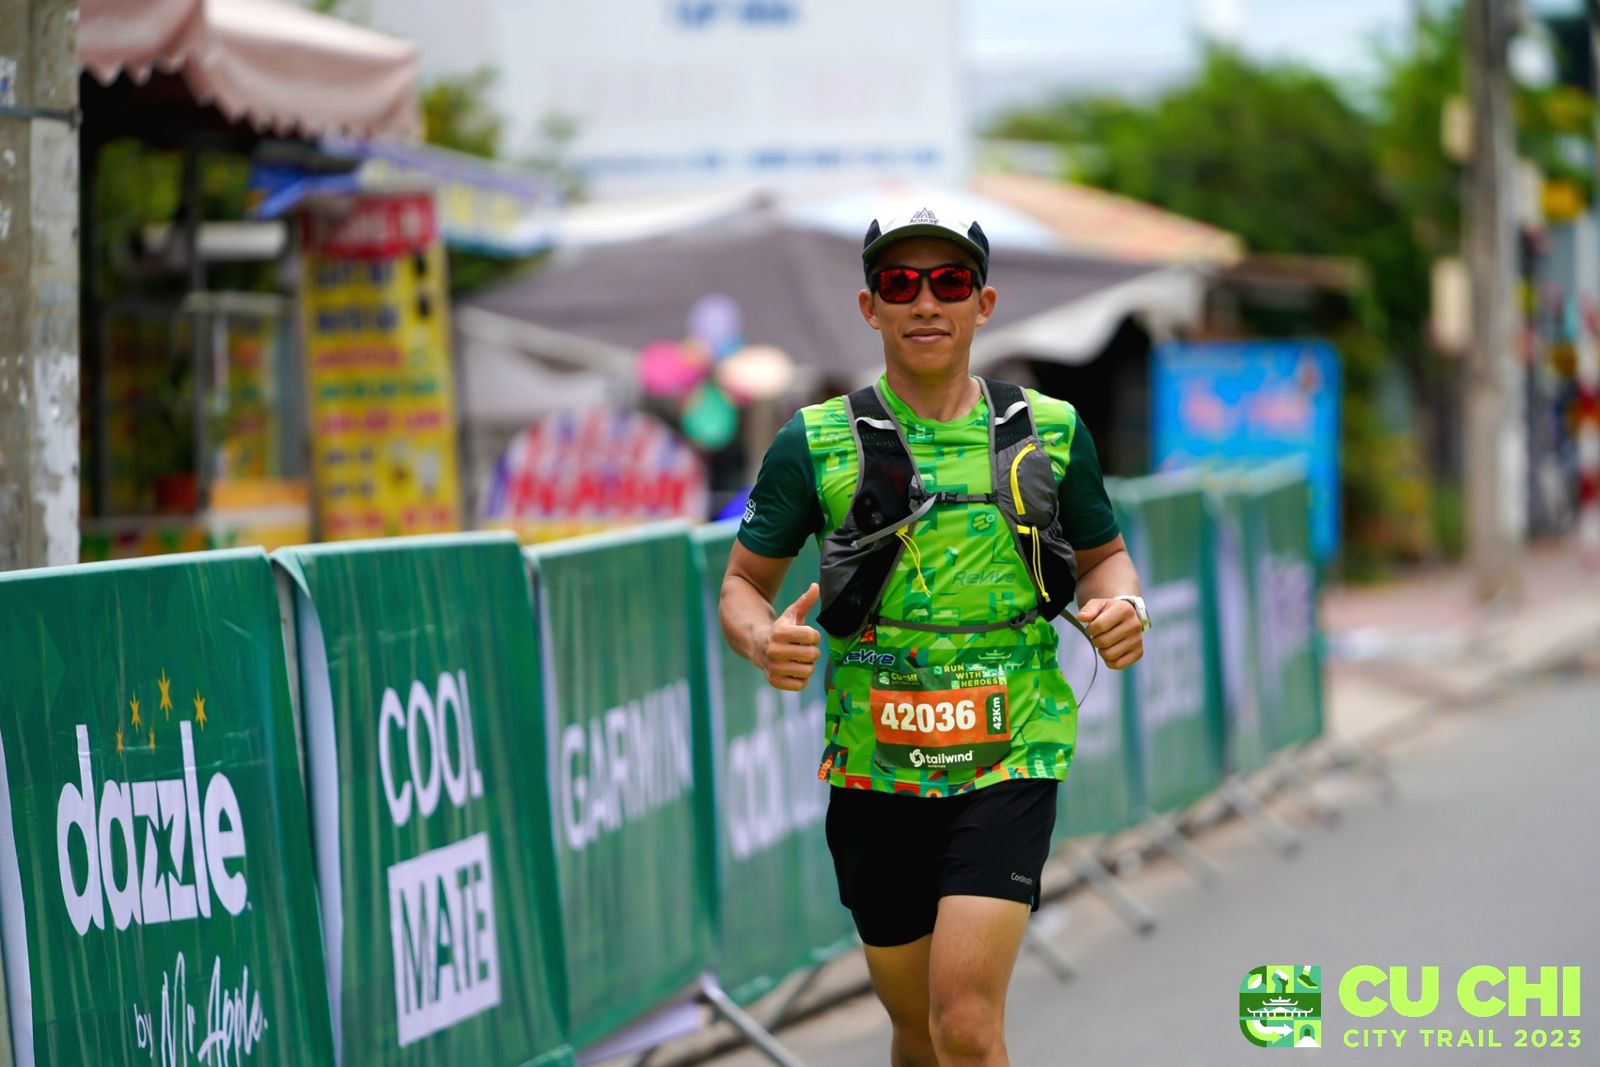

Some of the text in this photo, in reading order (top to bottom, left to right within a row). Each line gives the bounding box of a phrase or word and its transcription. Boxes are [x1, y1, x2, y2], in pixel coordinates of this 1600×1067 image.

[843, 648, 896, 665] eVive
[943, 664, 965, 673] RUN
[955, 670, 982, 680] WITH
[960, 678, 999, 688] HEROES
[880, 699, 977, 734] 42036
[993, 696, 1002, 731] 42Km
[379, 669, 484, 827] COOL
[925, 750, 973, 764] tailwind
[57, 720, 248, 936] dazzle
[401, 859, 491, 1017] MATE
[133, 1002, 153, 1059] by
